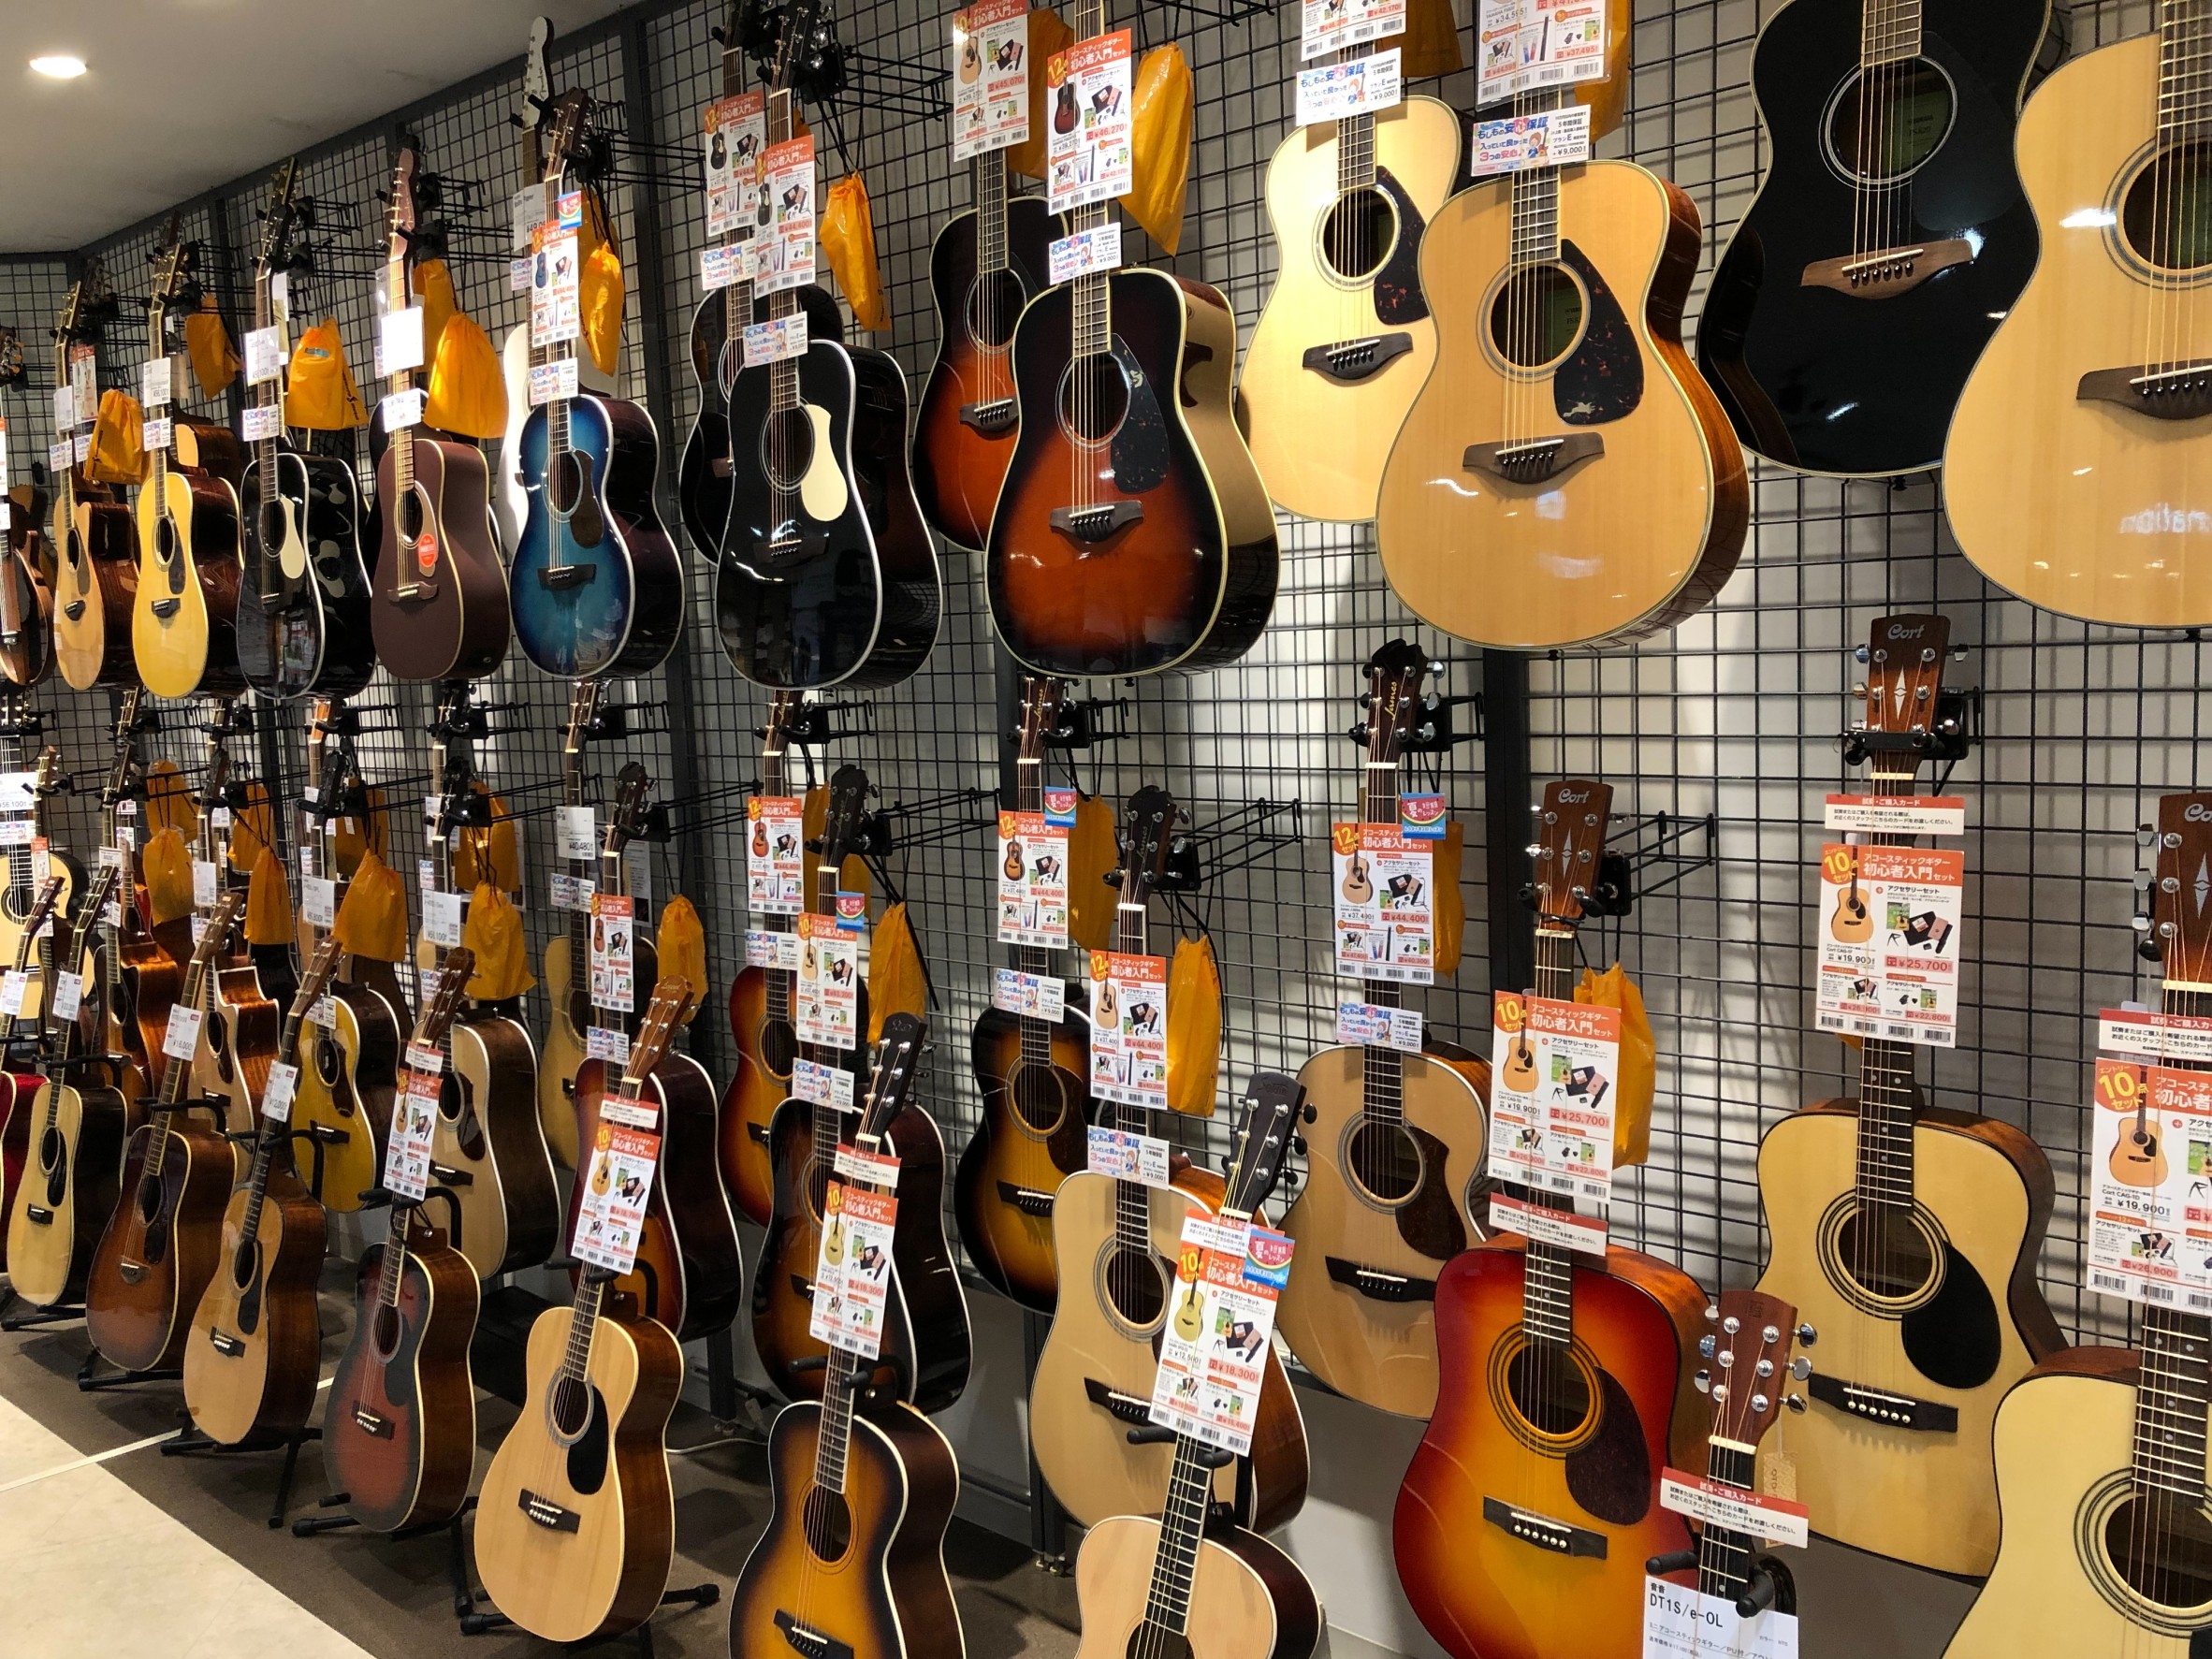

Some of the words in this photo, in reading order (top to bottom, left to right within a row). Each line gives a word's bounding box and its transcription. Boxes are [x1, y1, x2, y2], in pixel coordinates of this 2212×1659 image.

[1477, 116, 1549, 138] もしもの安心保証
[1888, 624, 1925, 639] Cort
[1558, 789, 1590, 803] Cort
[1363, 837, 1427, 849] 初心者入門セット
[1864, 853, 1951, 866] アコースティックギター
[1864, 864, 1955, 881] 初心者入門セット
[1887, 885, 1940, 895] アクセサリーセット
[1111, 966, 1161, 979] 初心者入門セット
[1533, 1005, 1608, 1021] アコースティックギター
[1531, 1014, 1612, 1036] 初心者入門セット
[1552, 1038, 1598, 1049] アクセサリーセット
[2099, 1072, 2148, 1099] 10点
[2112, 1098, 2143, 1111] セット
[2117, 1200, 2165, 1215] ¥19,900
[1207, 1266, 1273, 1295] 初心者入門セット
[1651, 1594, 1723, 1627] DT1S/e-OL
